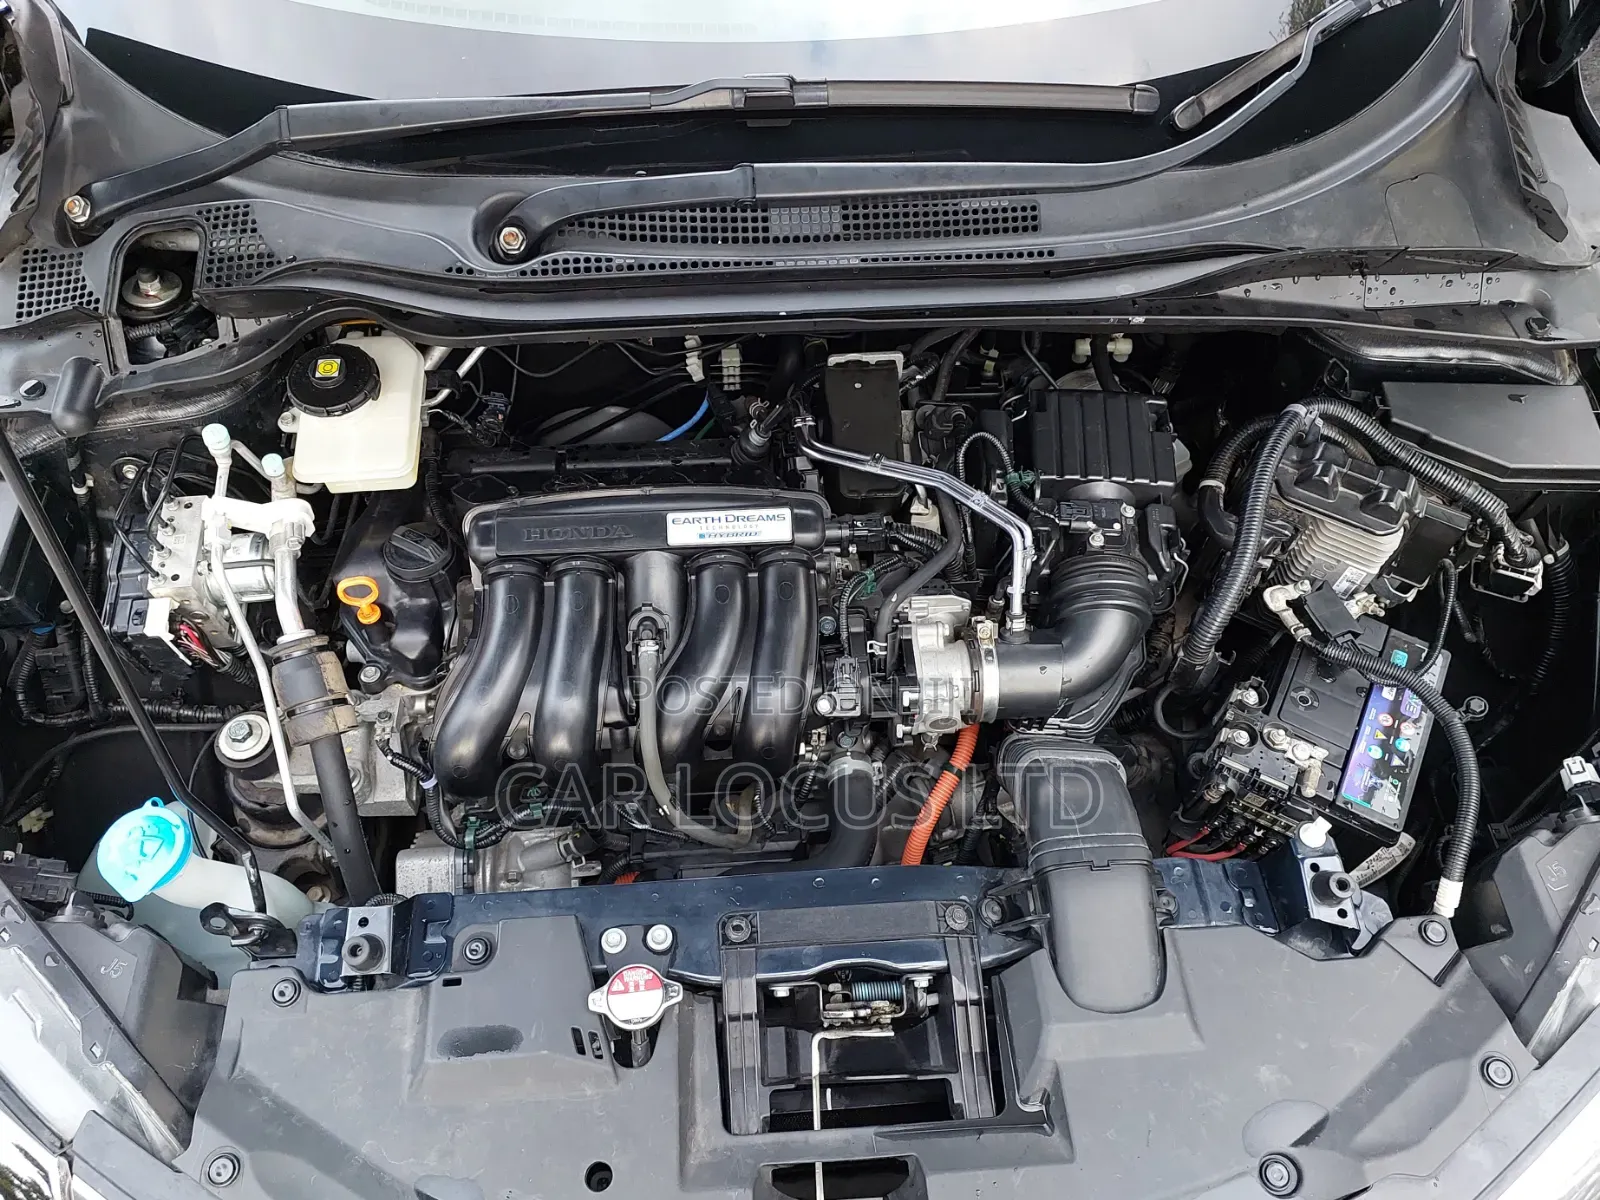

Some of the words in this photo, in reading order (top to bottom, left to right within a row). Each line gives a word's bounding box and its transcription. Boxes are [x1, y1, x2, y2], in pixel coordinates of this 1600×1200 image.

[671, 515, 721, 525] EARTH
[724, 513, 786, 523] DREAMS
[523, 525, 634, 541] HONDA
[707, 531, 758, 539] HYBRID
